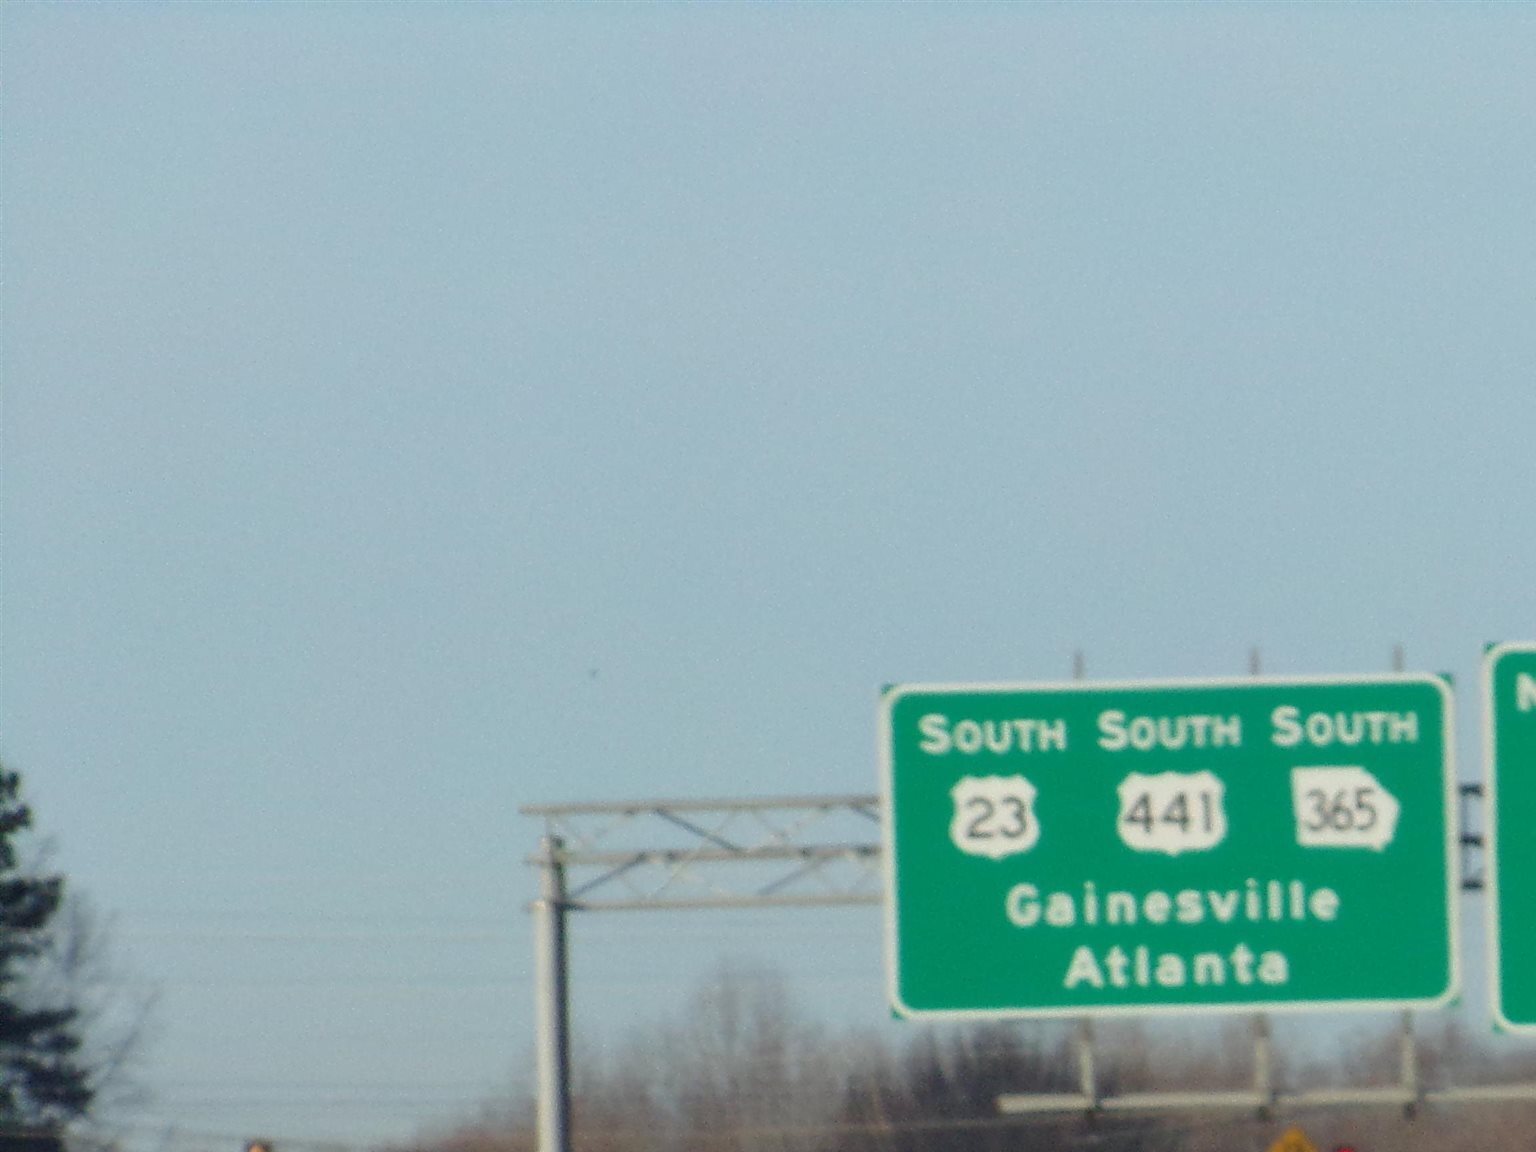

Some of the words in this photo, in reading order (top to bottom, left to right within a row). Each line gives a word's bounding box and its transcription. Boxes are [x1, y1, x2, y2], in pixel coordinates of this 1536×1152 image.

[918, 713, 1067, 755] SOUTH
[1097, 709, 1242, 751] SOUTH
[1271, 705, 1419, 747] SOUTH
[964, 796, 1029, 839] 23
[1123, 791, 1215, 834] 441
[1304, 786, 1379, 832] 365
[1005, 877, 1341, 928] Gainesville
[1063, 943, 1289, 988] Atlanta
